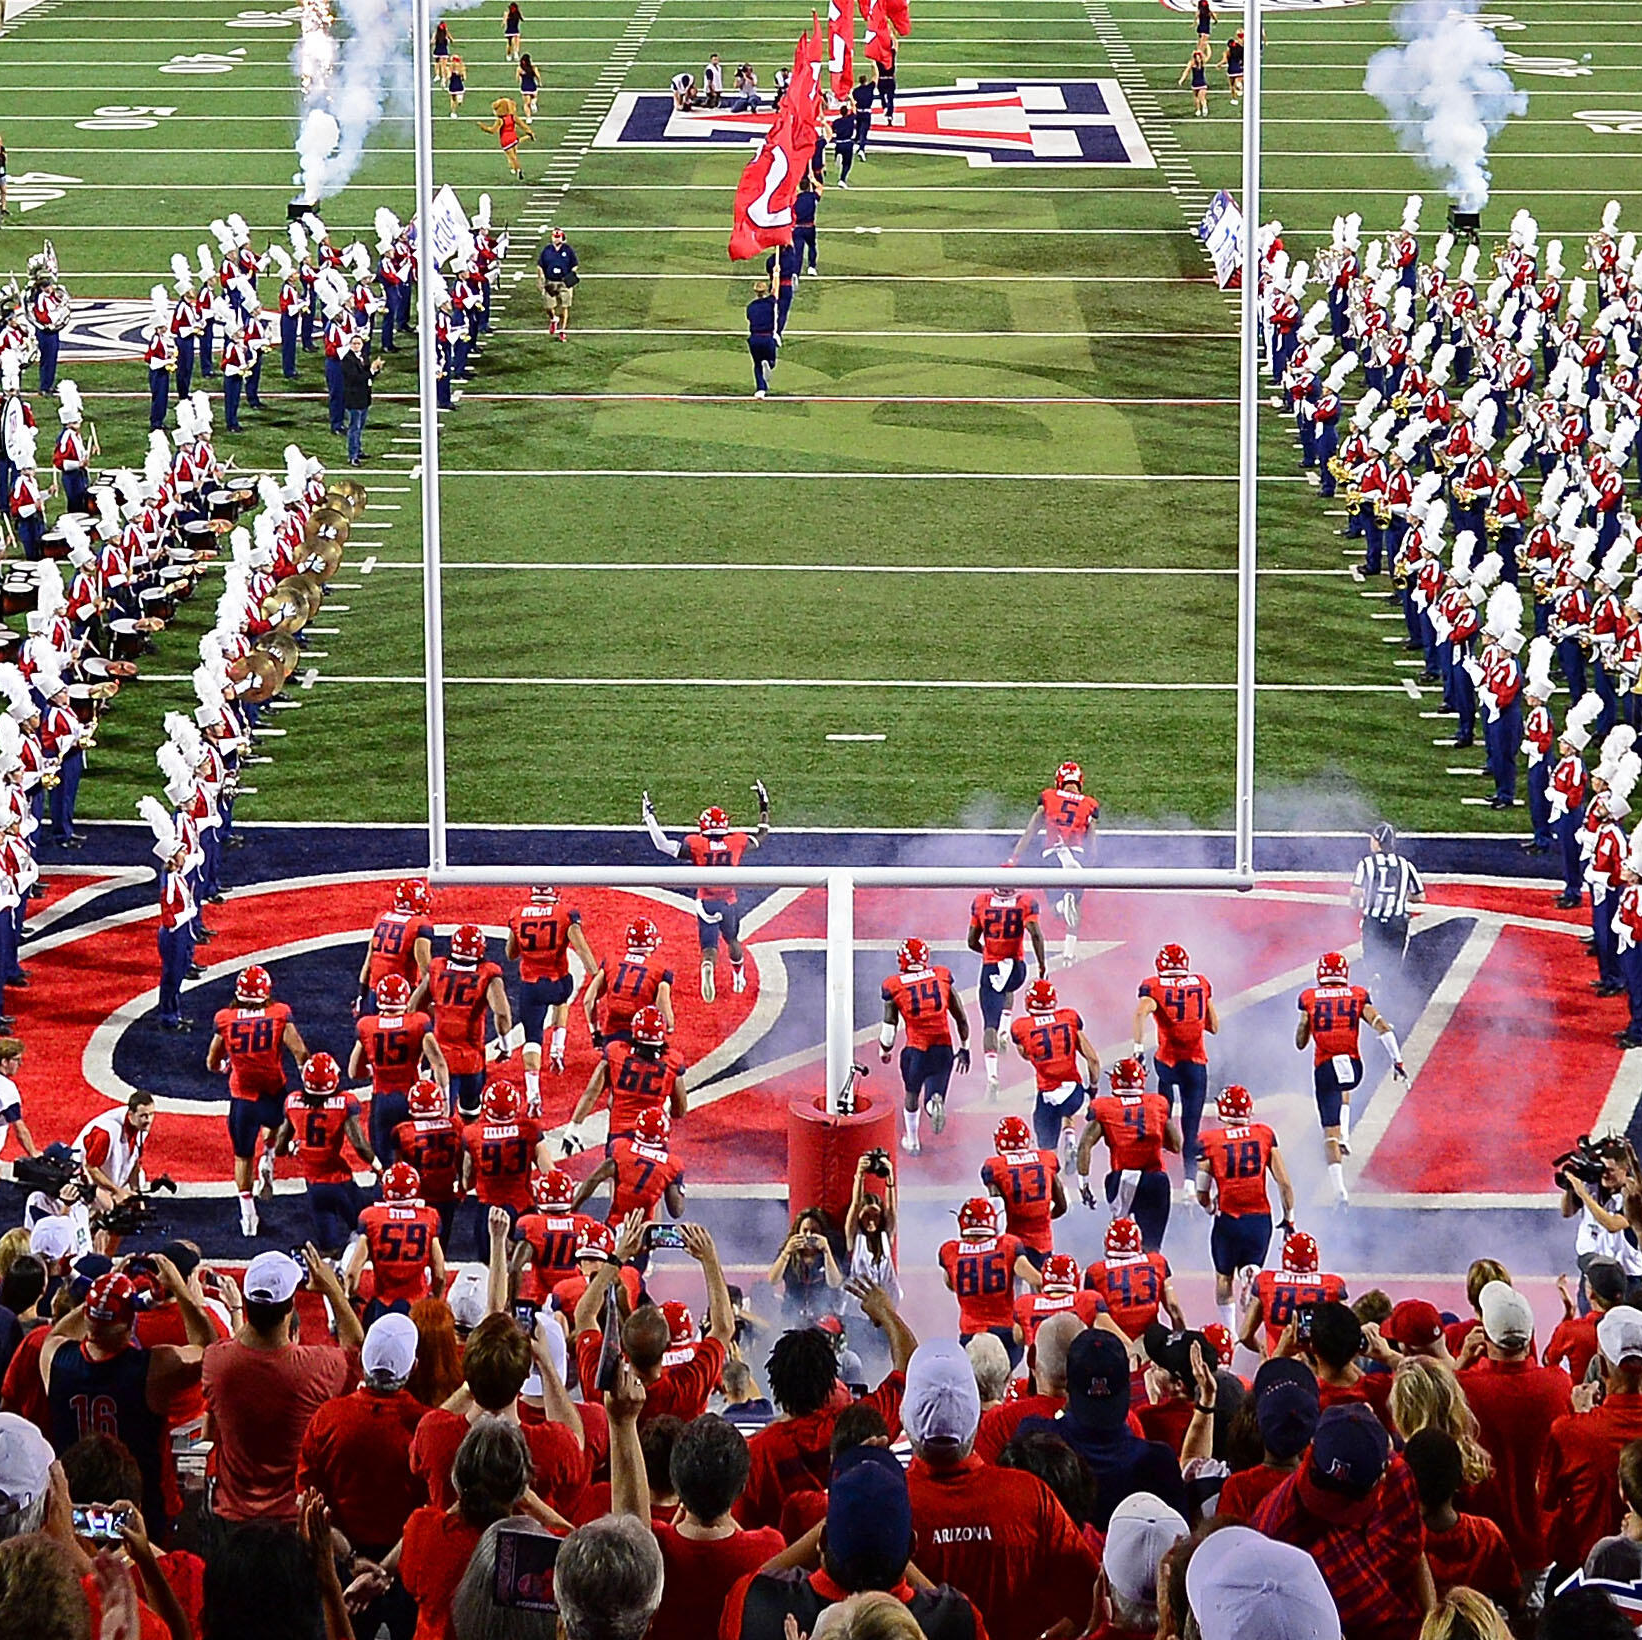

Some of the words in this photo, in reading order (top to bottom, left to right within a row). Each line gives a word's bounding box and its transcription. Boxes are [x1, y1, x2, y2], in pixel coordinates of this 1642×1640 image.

[1056, 800, 1079, 826] 5
[1377, 866, 1396, 893] L
[372, 922, 406, 955] 99
[519, 921, 557, 952] 57
[984, 908, 1024, 939] 28
[438, 971, 479, 1007] 72
[612, 962, 648, 997] 17
[910, 979, 942, 1017] 14
[1165, 987, 1204, 1022] 47
[1314, 998, 1358, 1032] 84
[230, 1017, 273, 1054] 58
[374, 1030, 409, 1067] 15
[1030, 1024, 1072, 1061] 37
[617, 1057, 664, 1095] 62
[306, 1113, 327, 1148] 6
[1123, 1106, 1145, 1140] 4
[415, 1132, 457, 1168] 25
[482, 1139, 528, 1177] 93
[1223, 1141, 1260, 1179] 18
[634, 1157, 656, 1193] 7
[1008, 1164, 1047, 1203] 13
[379, 1223, 427, 1261] 59
[541, 1231, 579, 1269] 10
[956, 1252, 1006, 1296] 86
[1107, 1266, 1157, 1307] 43
[69, 1394, 119, 1440] 16
[932, 1526, 993, 1545] ARIZONA
